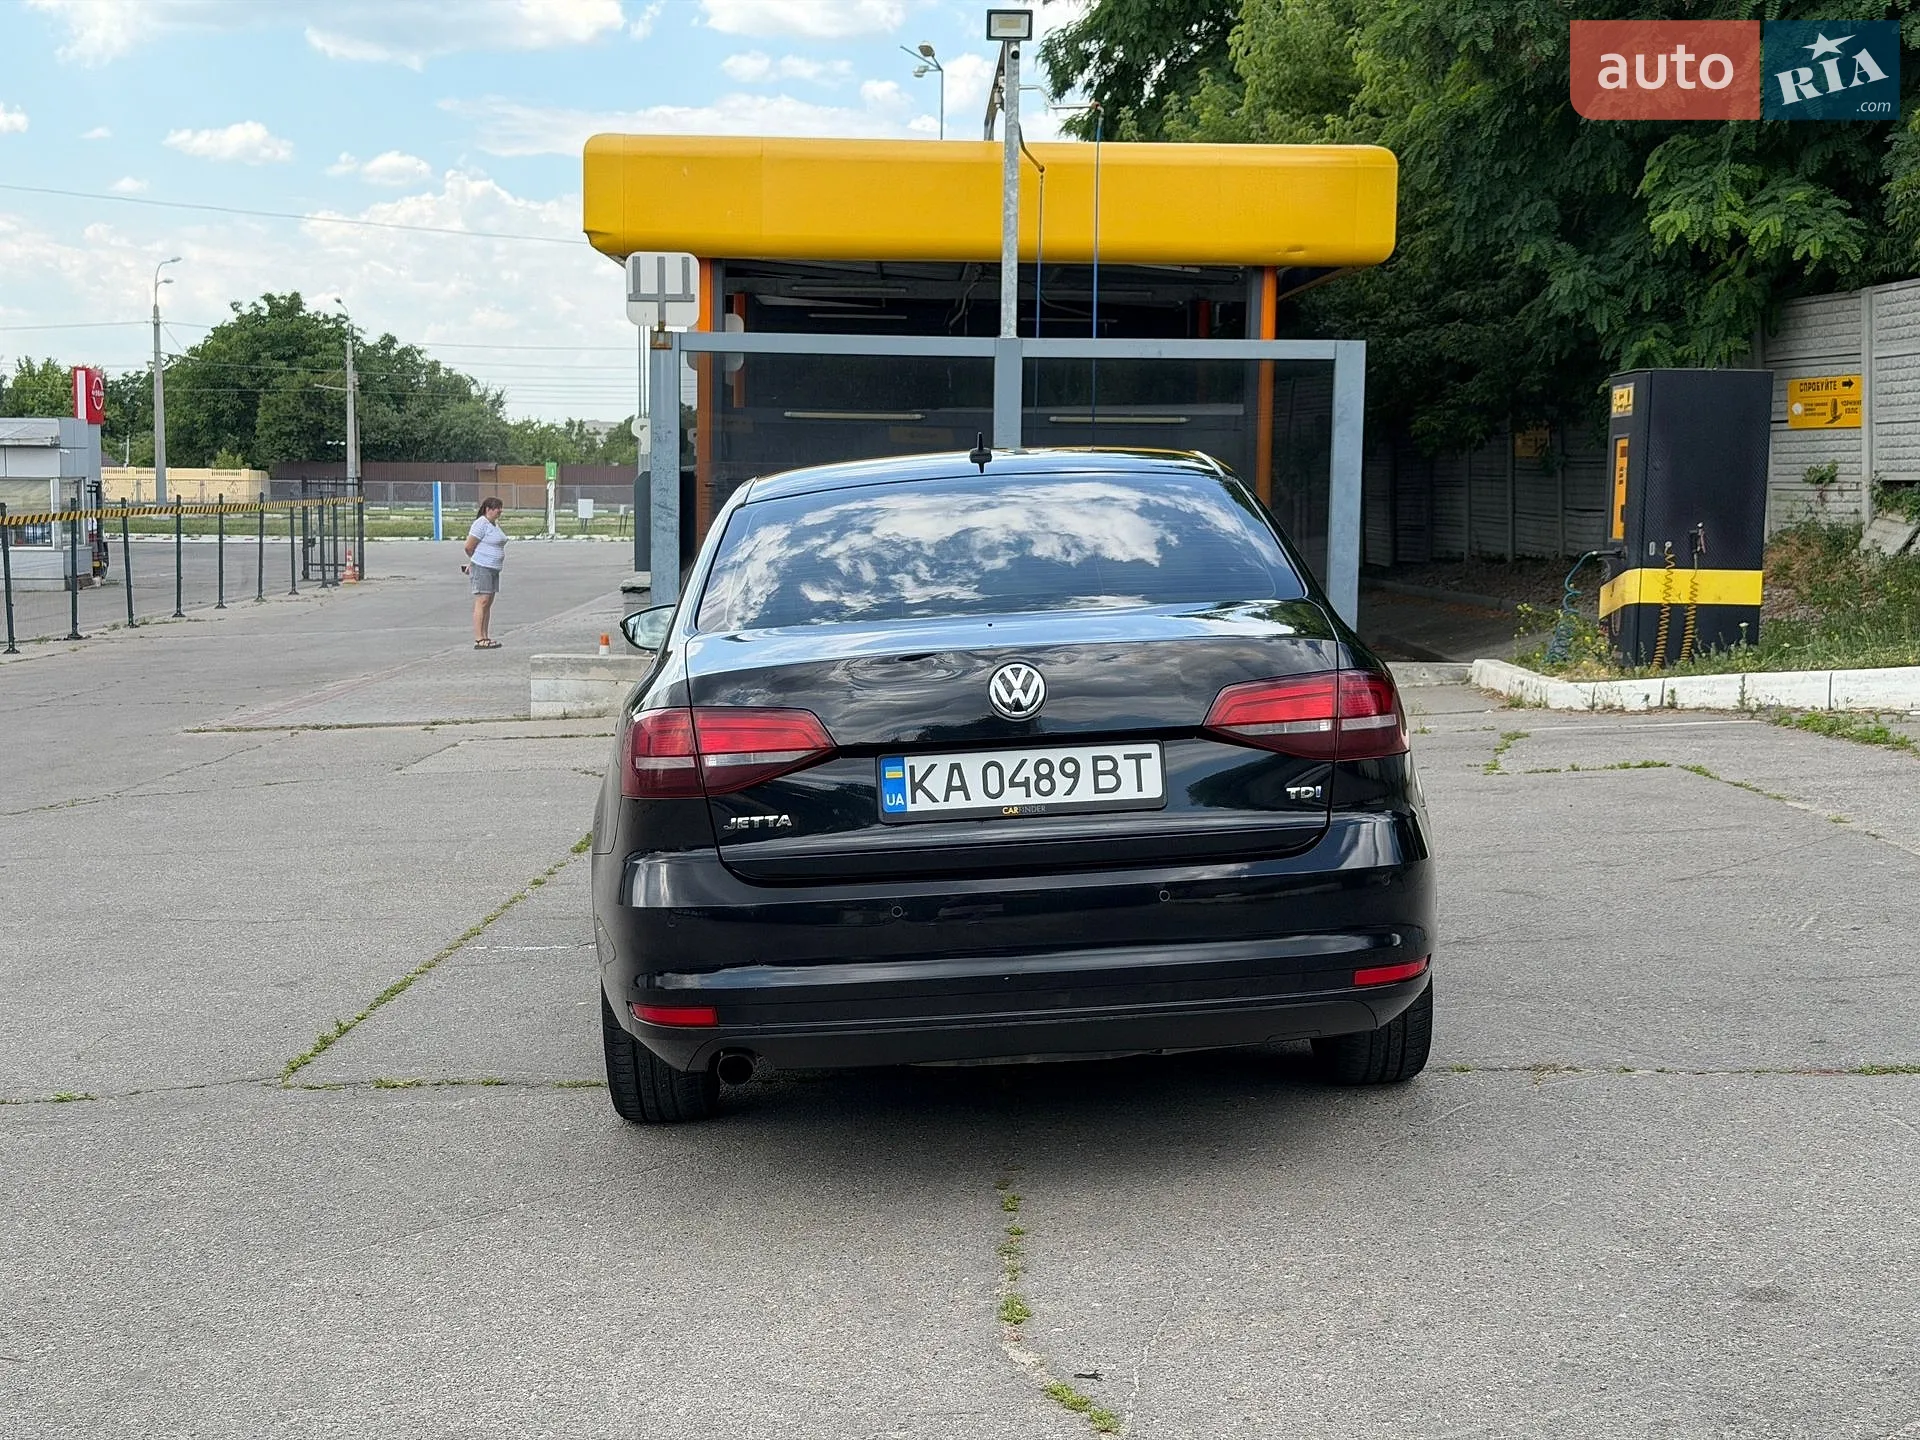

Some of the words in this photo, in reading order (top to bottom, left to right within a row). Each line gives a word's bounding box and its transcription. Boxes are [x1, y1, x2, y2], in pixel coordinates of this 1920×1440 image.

[981, 756, 1081, 800] 0489
[886, 793, 904, 806] UA
[1286, 785, 1322, 800] TDI
[723, 814, 793, 830] JETTA
